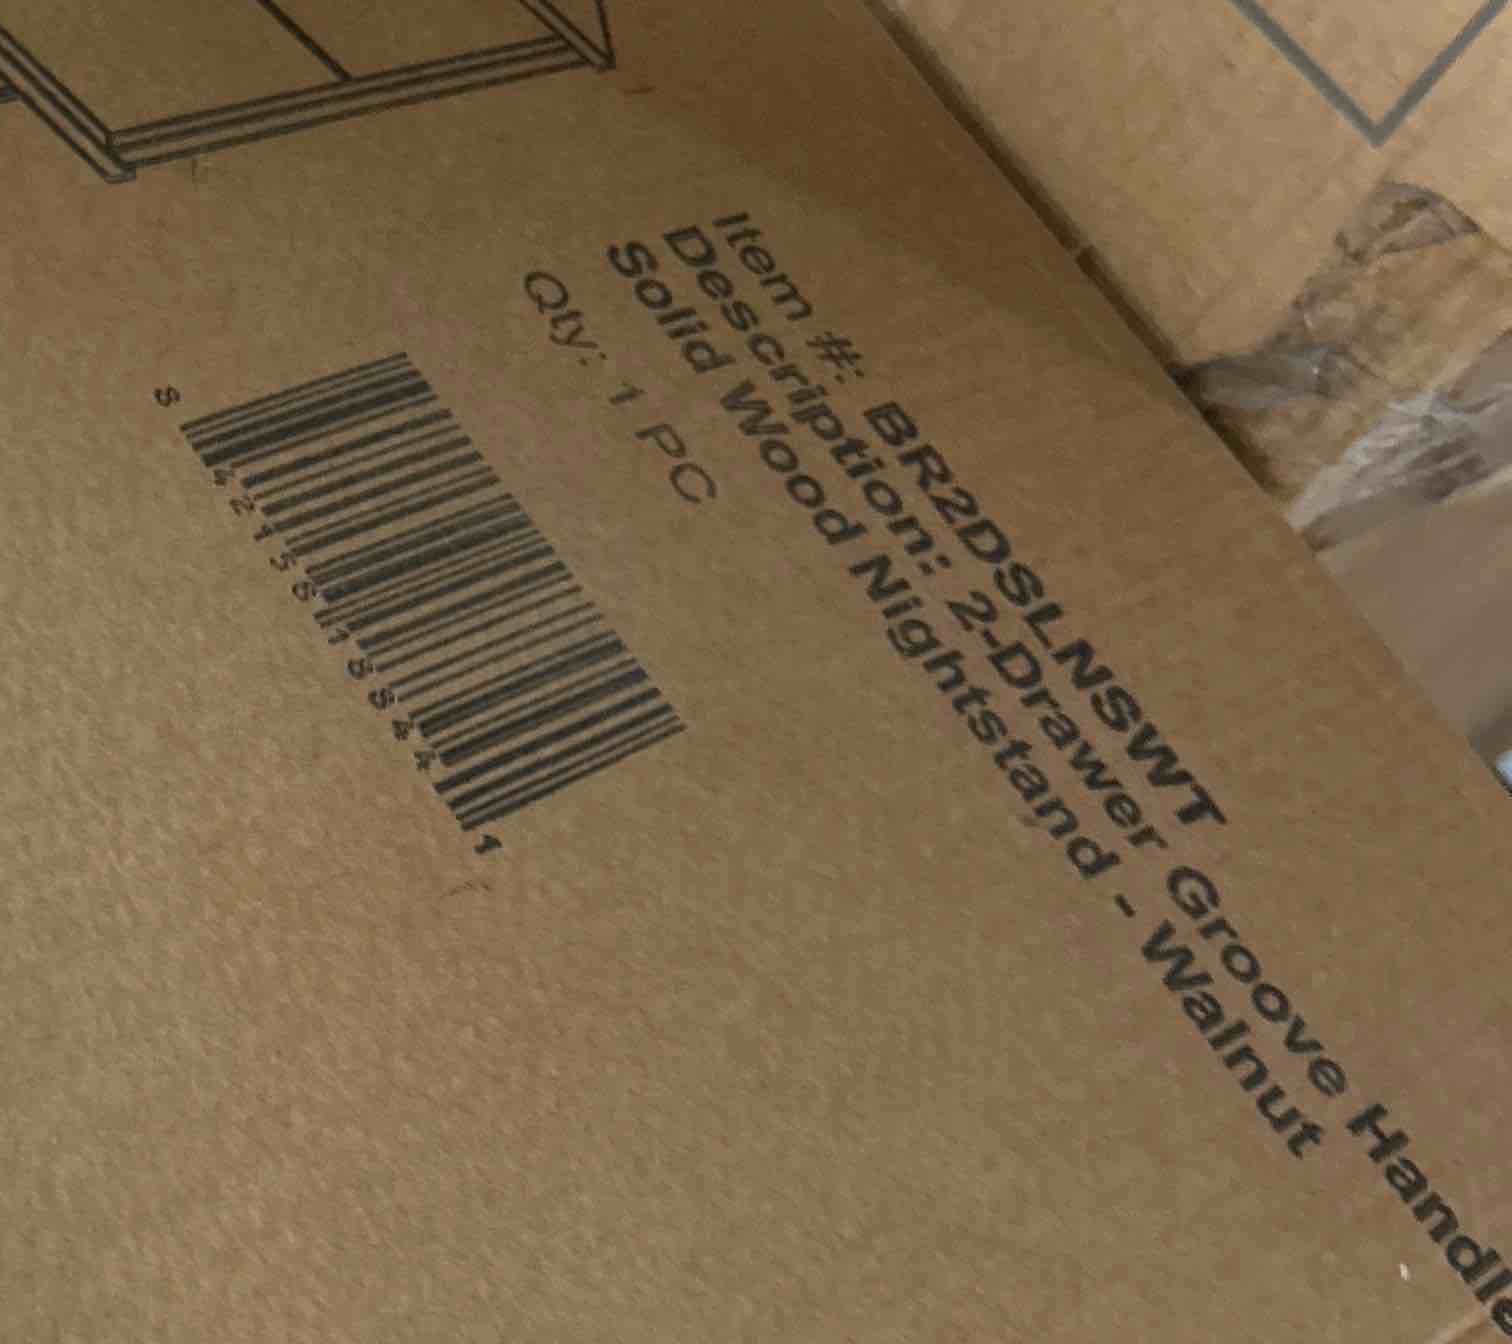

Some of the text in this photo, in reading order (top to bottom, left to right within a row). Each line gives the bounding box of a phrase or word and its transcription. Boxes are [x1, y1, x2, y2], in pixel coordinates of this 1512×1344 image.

[524, 271, 606, 366] Qty:
[635, 423, 716, 504] PC
[607, 241, 735, 373] Solid
[720, 380, 867, 545] Wood
[848, 554, 1121, 880] Nightstand
[1141, 920, 1323, 1160] Walnut
[663, 225, 951, 575] Description:
[946, 592, 1168, 848] 2-Drawer
[1167, 866, 1346, 1096] Groove
[714, 212, 1227, 825] Item #: BR2DSLNSWT
